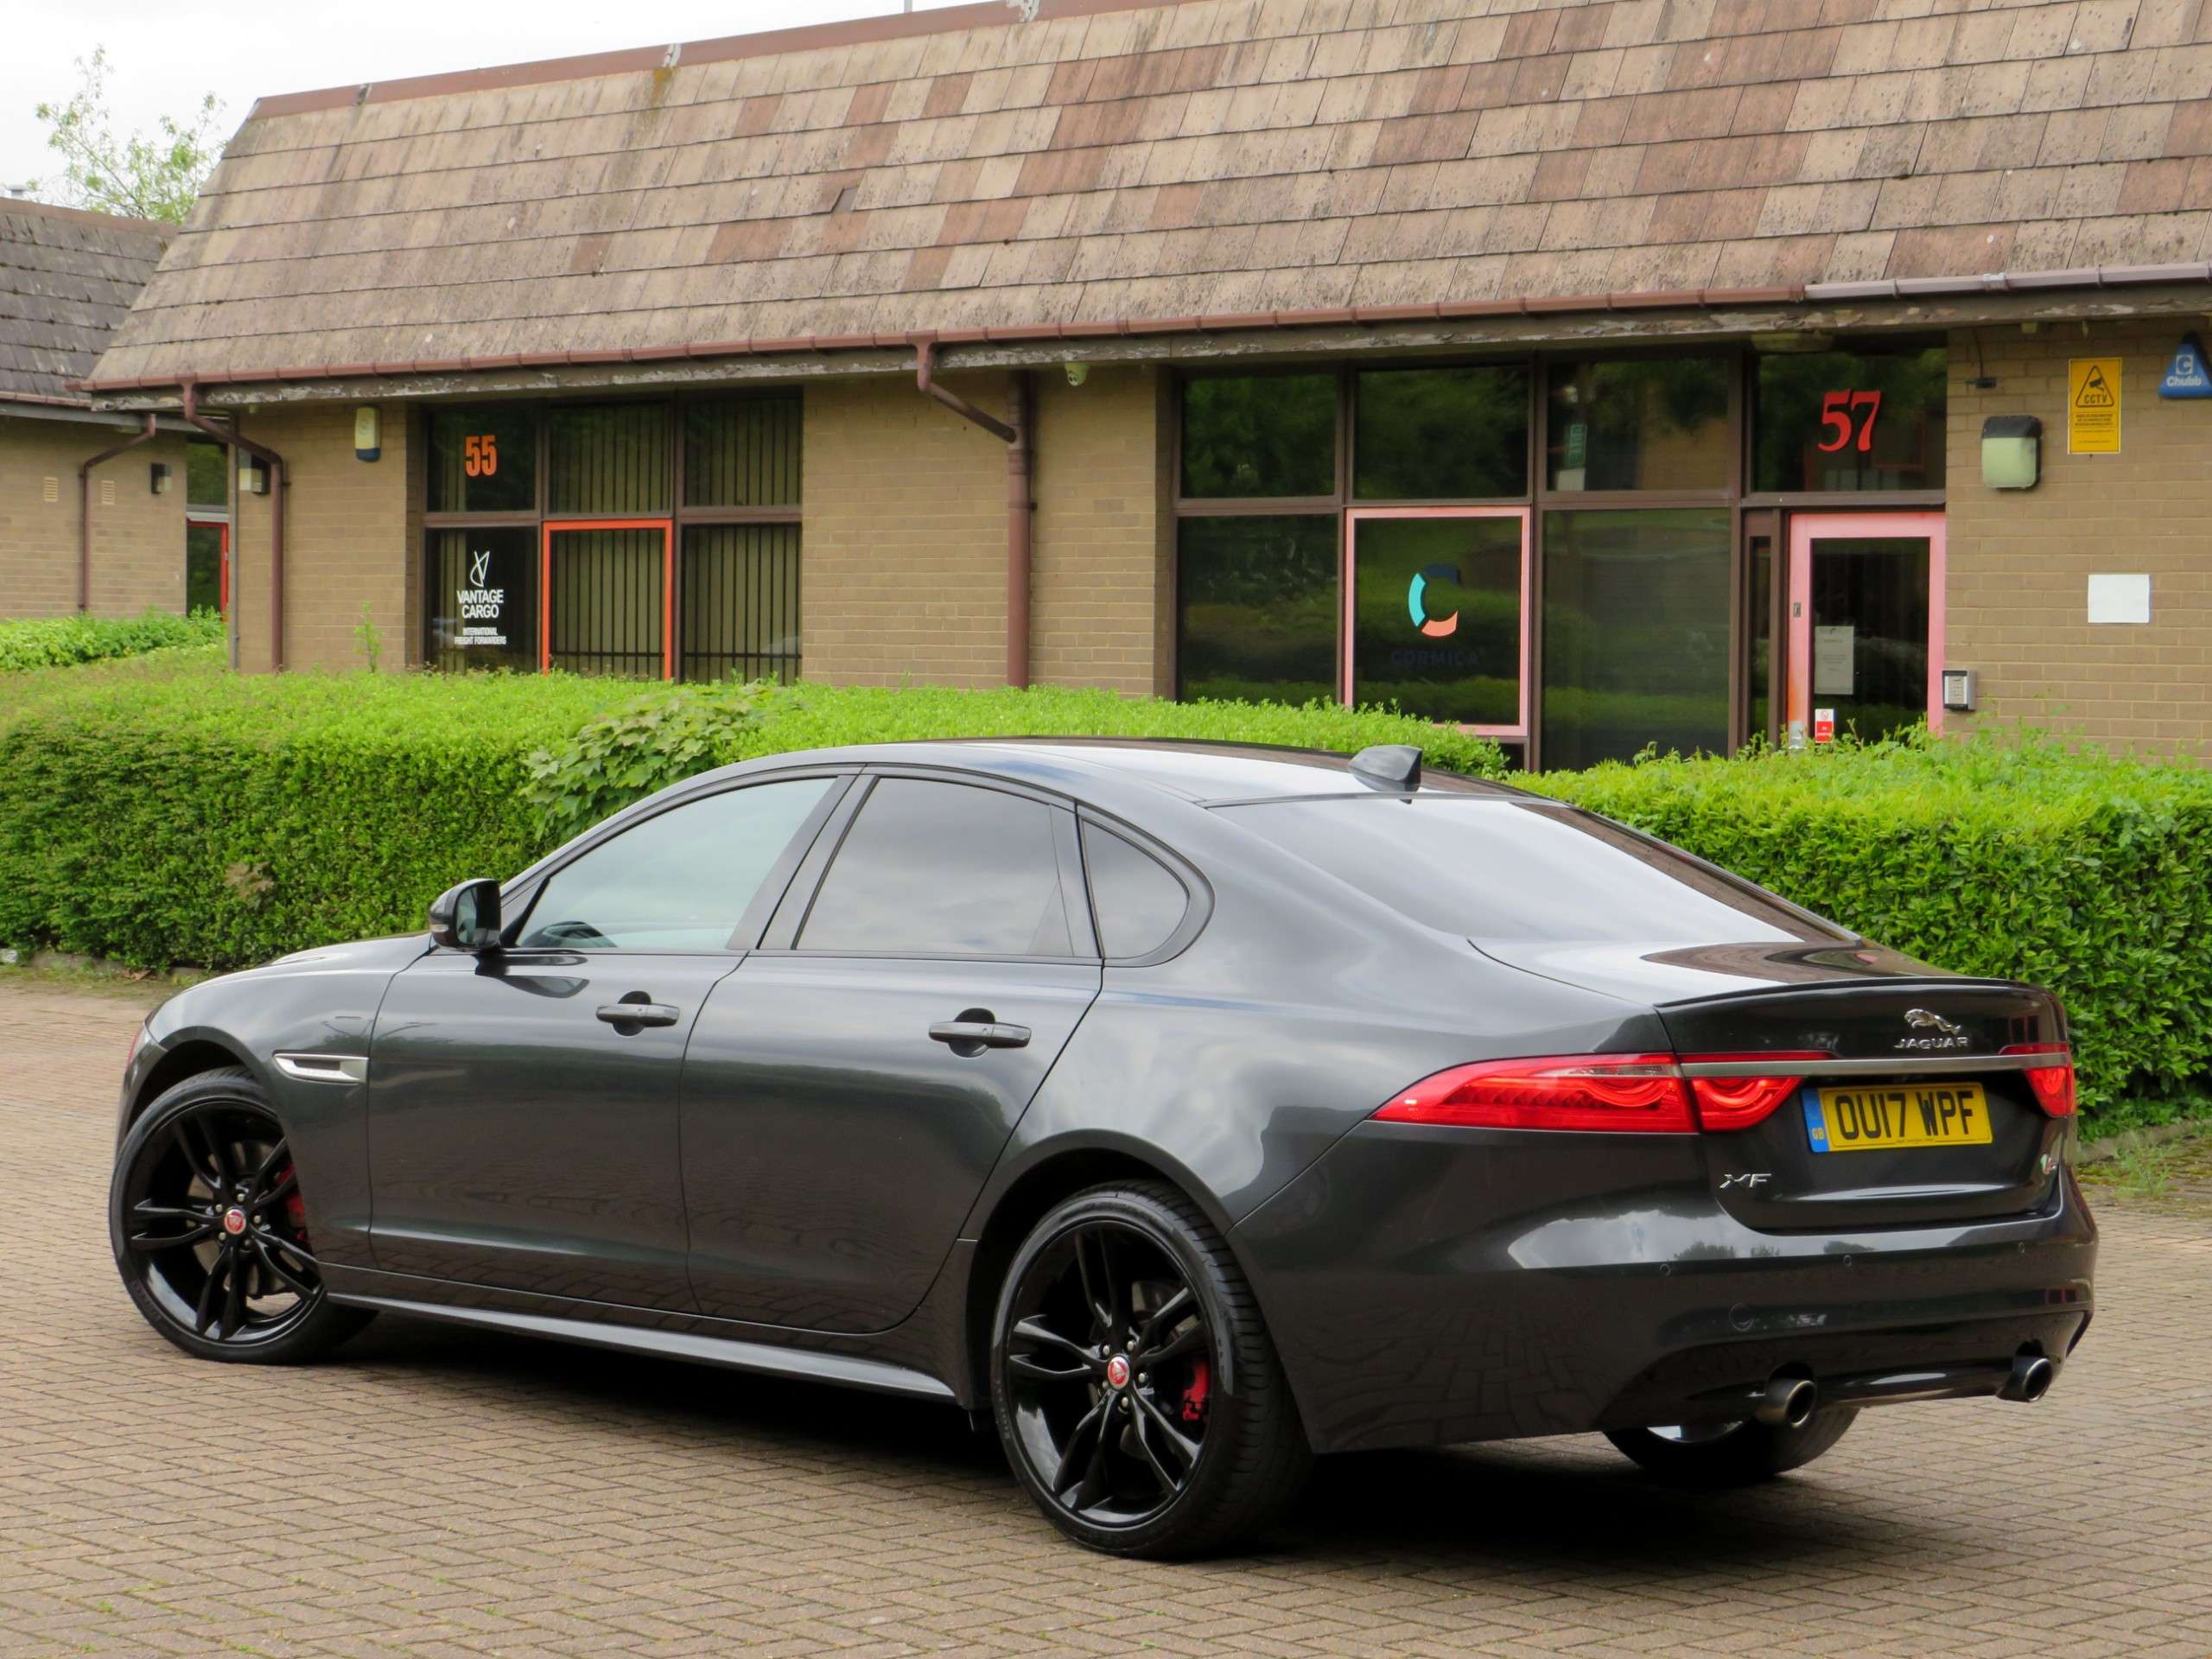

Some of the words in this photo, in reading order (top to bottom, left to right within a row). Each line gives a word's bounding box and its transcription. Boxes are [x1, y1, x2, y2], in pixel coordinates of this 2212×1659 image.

[2166, 375, 2202, 387] Chubb
[2084, 394, 2108, 404] CCTV
[1818, 389, 1881, 451] 57
[466, 435, 497, 476] 55
[456, 589, 504, 604] VANTAGE
[462, 604, 499, 619] CARGO
[1894, 1037, 1969, 1049] JAGUAR
[1834, 1092, 1906, 1141] OU17
[1916, 1090, 1974, 1136] WPF
[1811, 1127, 1826, 1141] GB
[1719, 1173, 1772, 1189] XF
